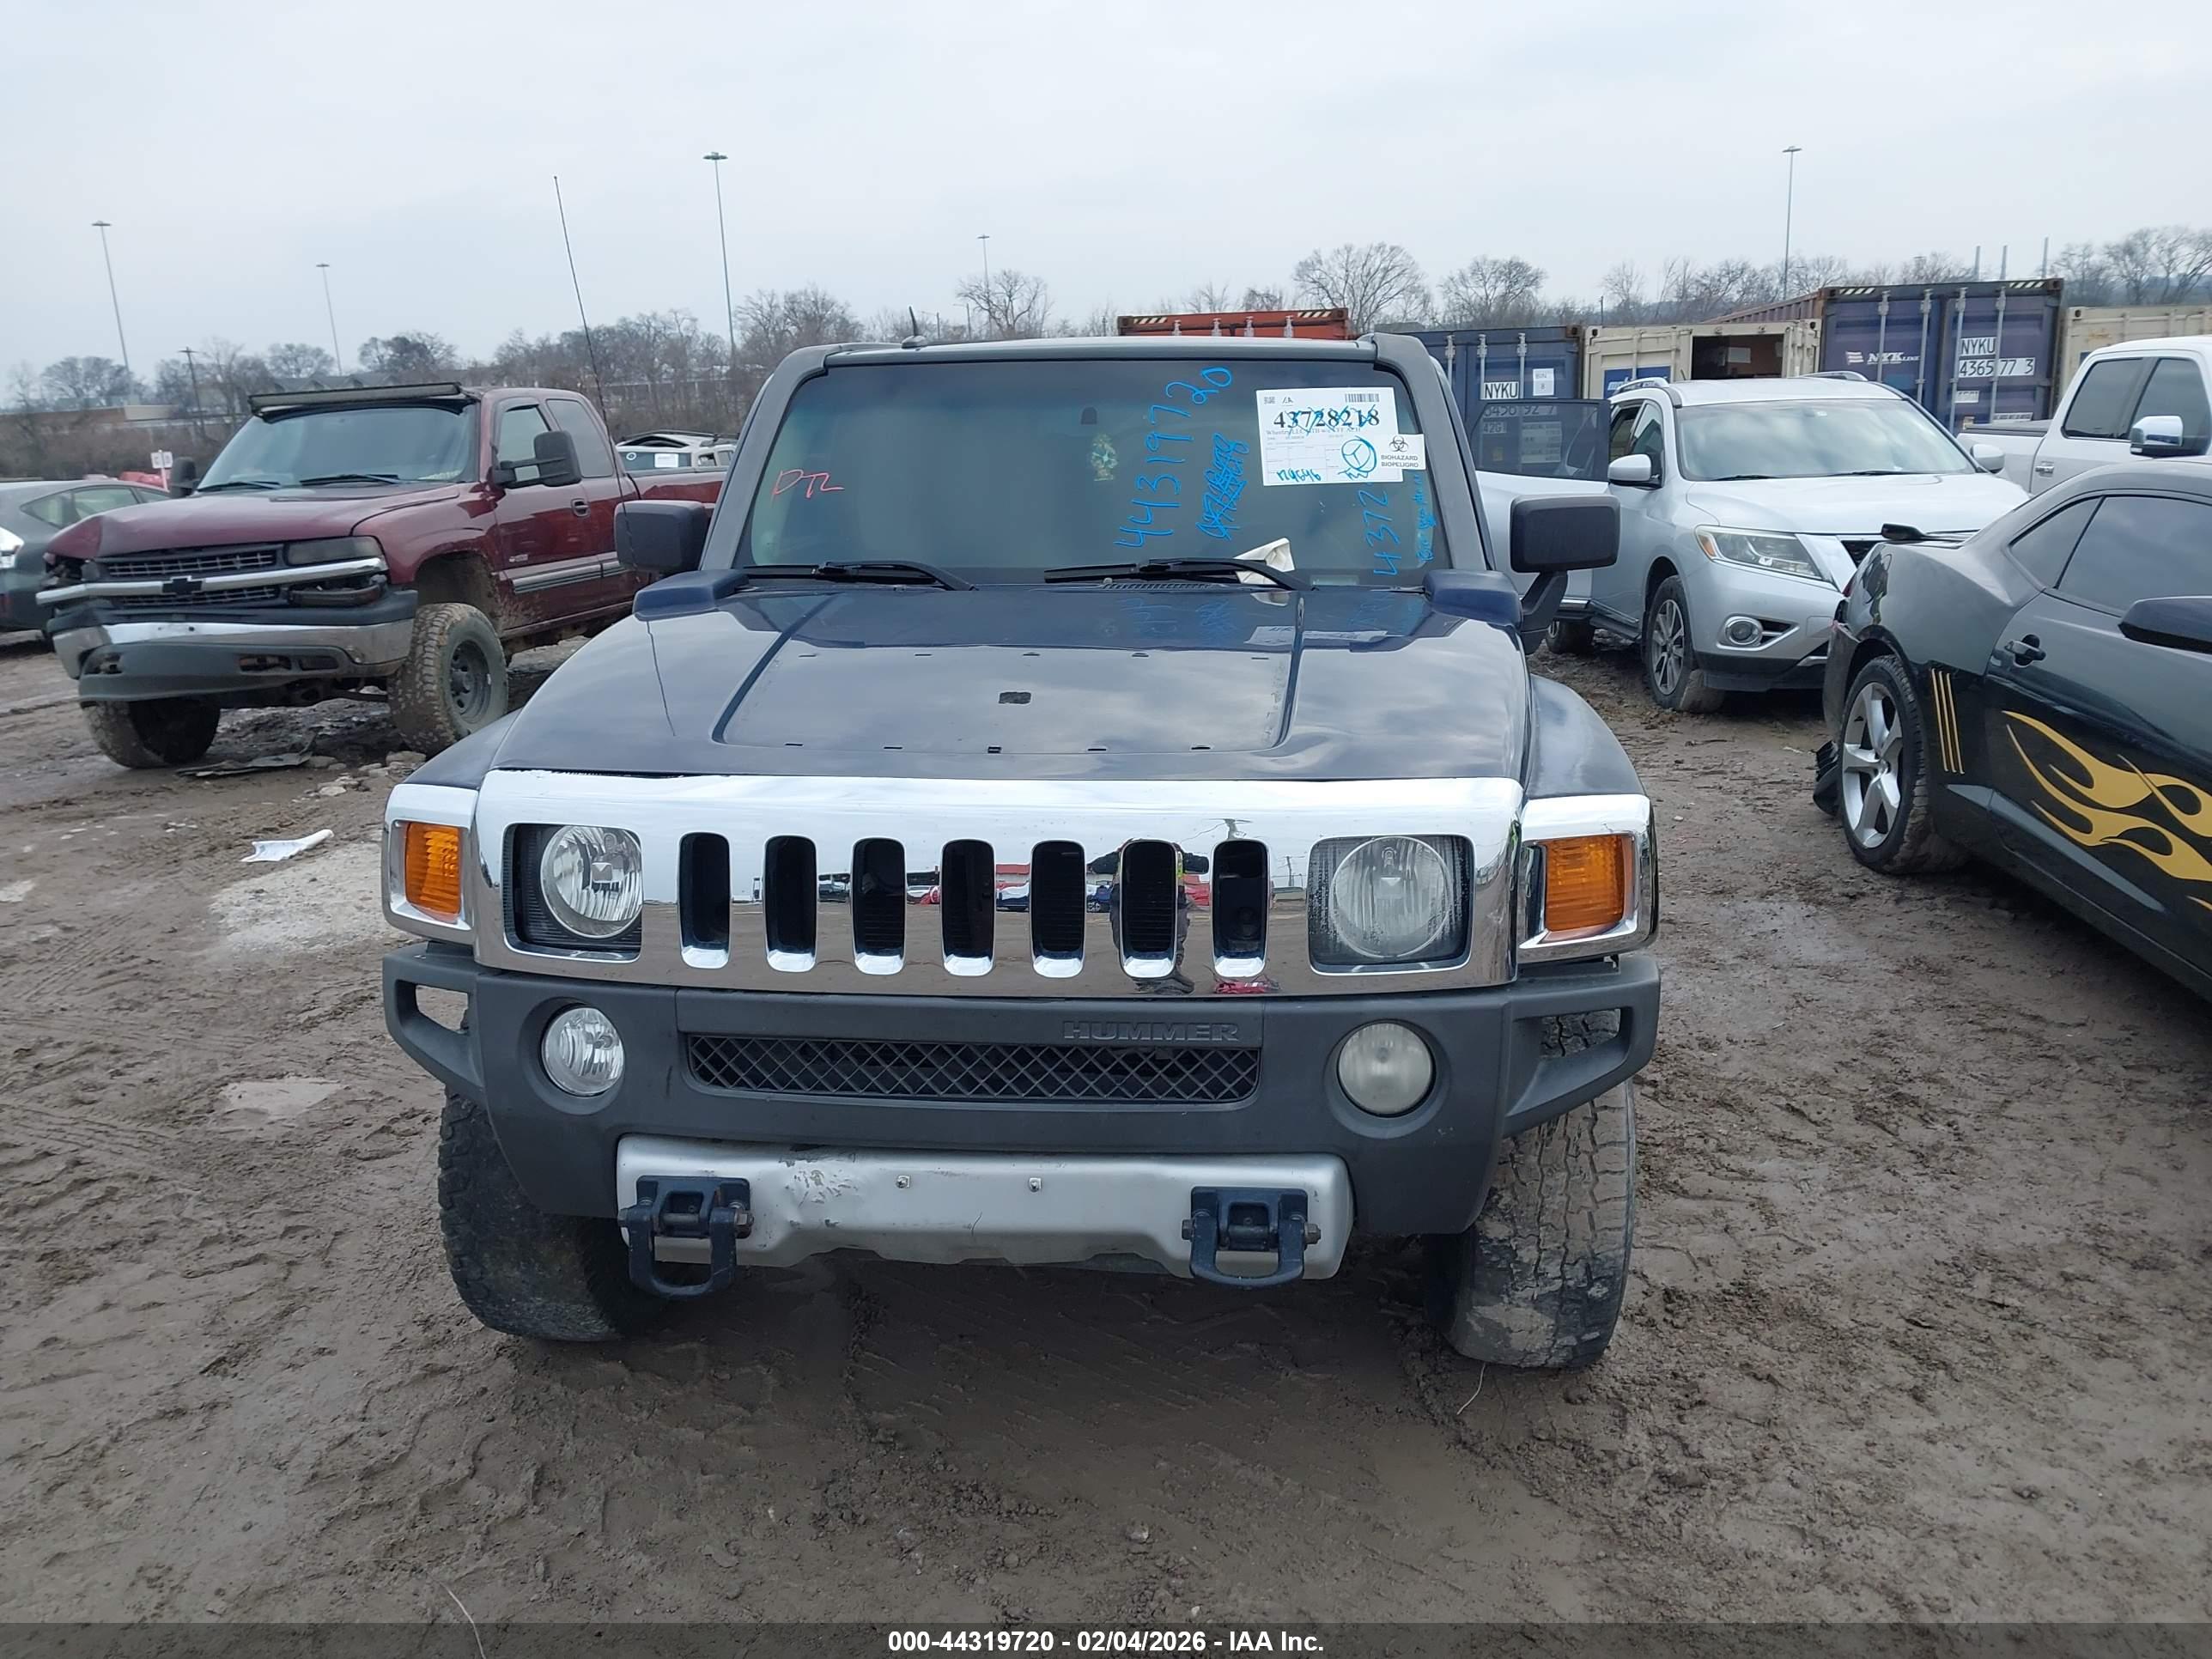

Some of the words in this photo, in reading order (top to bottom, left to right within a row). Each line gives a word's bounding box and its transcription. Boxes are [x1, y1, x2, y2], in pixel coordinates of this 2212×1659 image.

[1960, 337, 1996, 355] NYKU
[1868, 351, 1904, 362] NYK
[1960, 360, 1995, 376] 4365
[2000, 359, 2017, 375] 77
[2024, 358, 2034, 374] 3
[1484, 383, 1518, 399] NYKU
[1273, 408, 1381, 429] 43728218
[1113, 367, 1232, 548] 44319720
[1063, 1021, 1239, 1041] HUMMER
